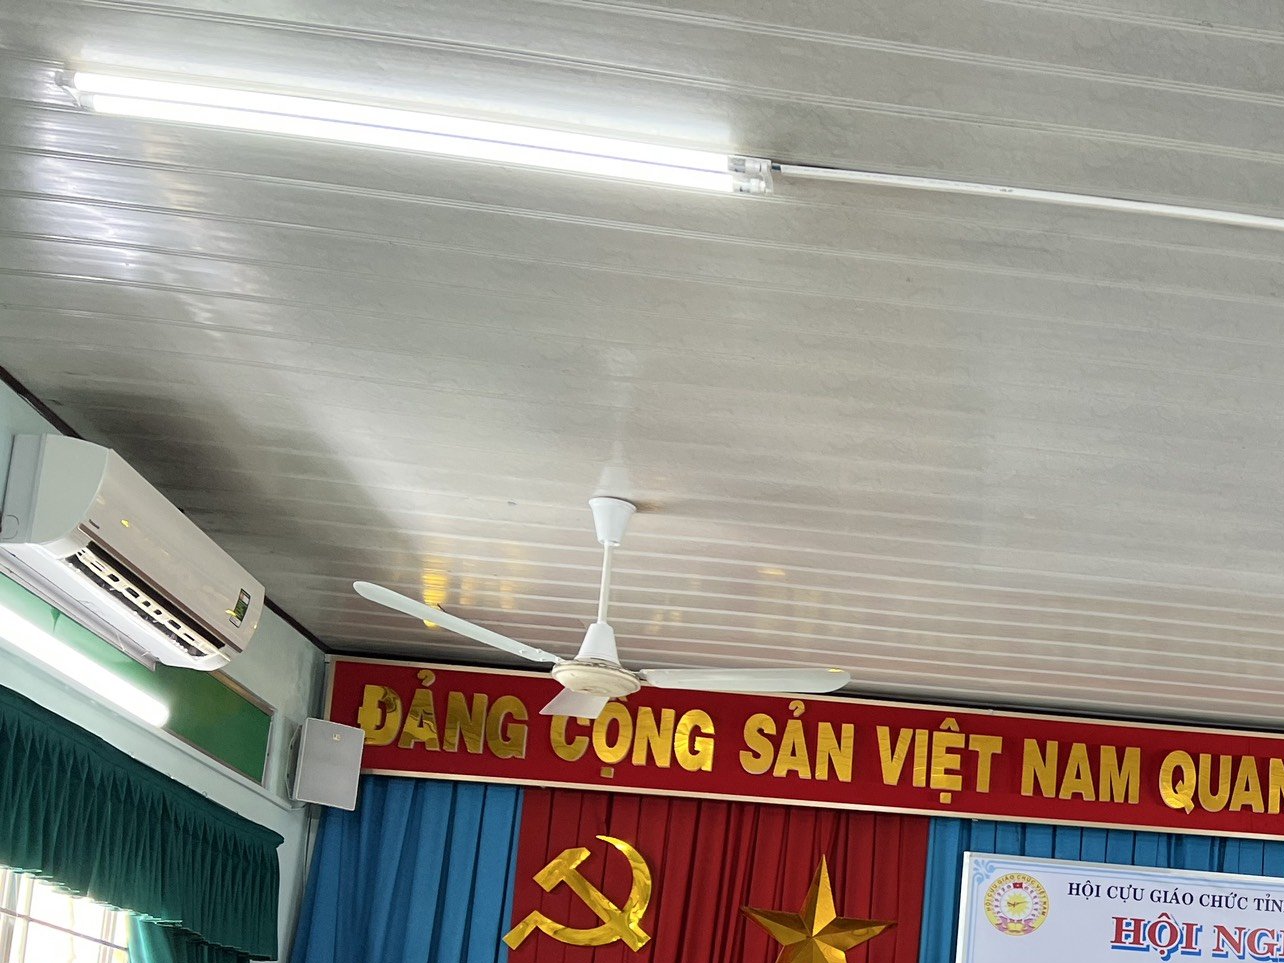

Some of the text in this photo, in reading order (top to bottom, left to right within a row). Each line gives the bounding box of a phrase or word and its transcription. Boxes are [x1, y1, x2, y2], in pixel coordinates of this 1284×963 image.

[358, 669, 528, 759] ĐẢNG
[739, 700, 854, 782] SẢN
[877, 717, 1003, 803] VIỆT
[1021, 739, 1140, 804] NAM
[1068, 880, 1101, 900] HỘI
[1107, 884, 1144, 903] CỰU
[1150, 888, 1193, 906] GIÁO
[1200, 892, 1248, 910] CHỨC
[1110, 912, 1202, 961] HỘI
